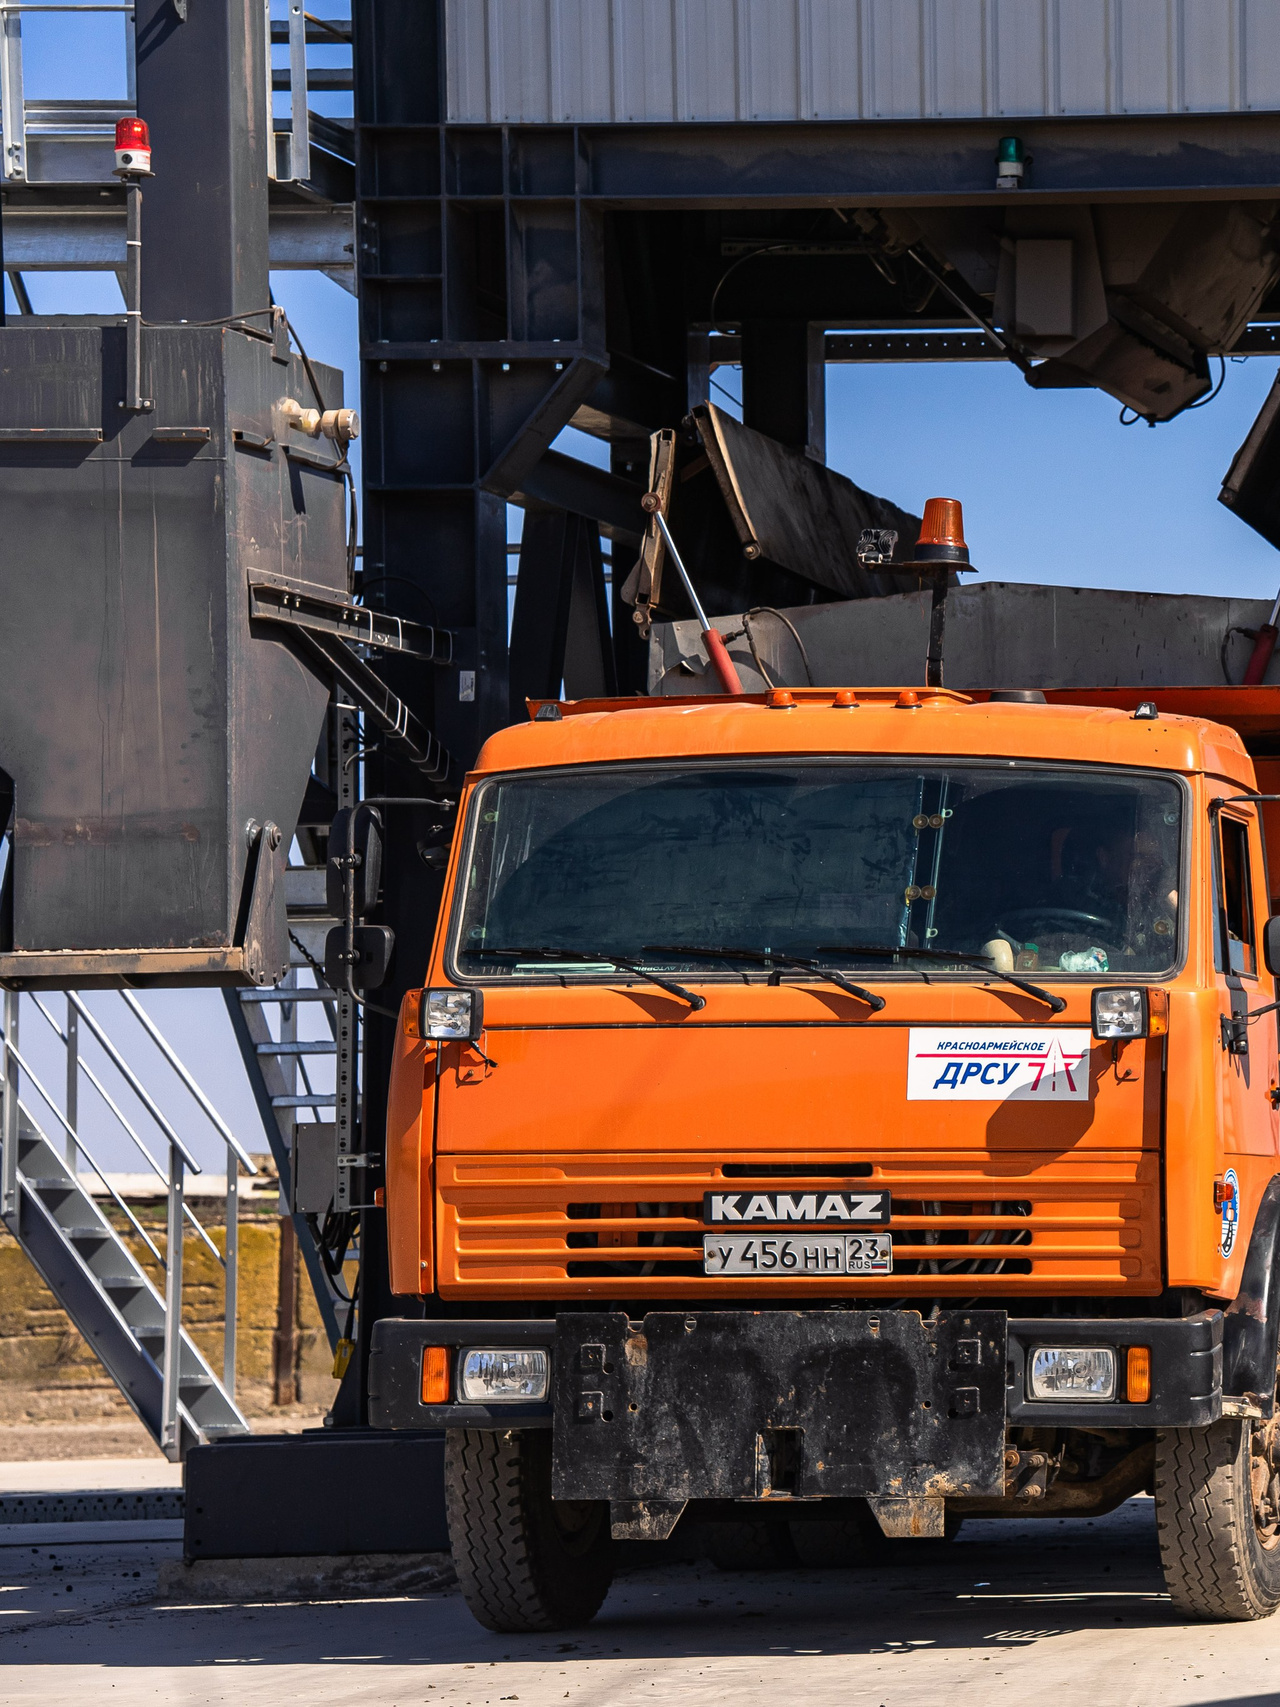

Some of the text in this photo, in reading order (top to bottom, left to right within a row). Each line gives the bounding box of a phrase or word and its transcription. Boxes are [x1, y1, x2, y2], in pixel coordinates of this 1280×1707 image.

[937, 1040, 1046, 1051] КРАСНОАРМЕЙСКОЕ
[932, 1062, 1020, 1089] ДРСУ
[711, 1194, 883, 1221] KAMAZ
[849, 1238, 879, 1260] 23
[848, 1260, 871, 1269] RUS
